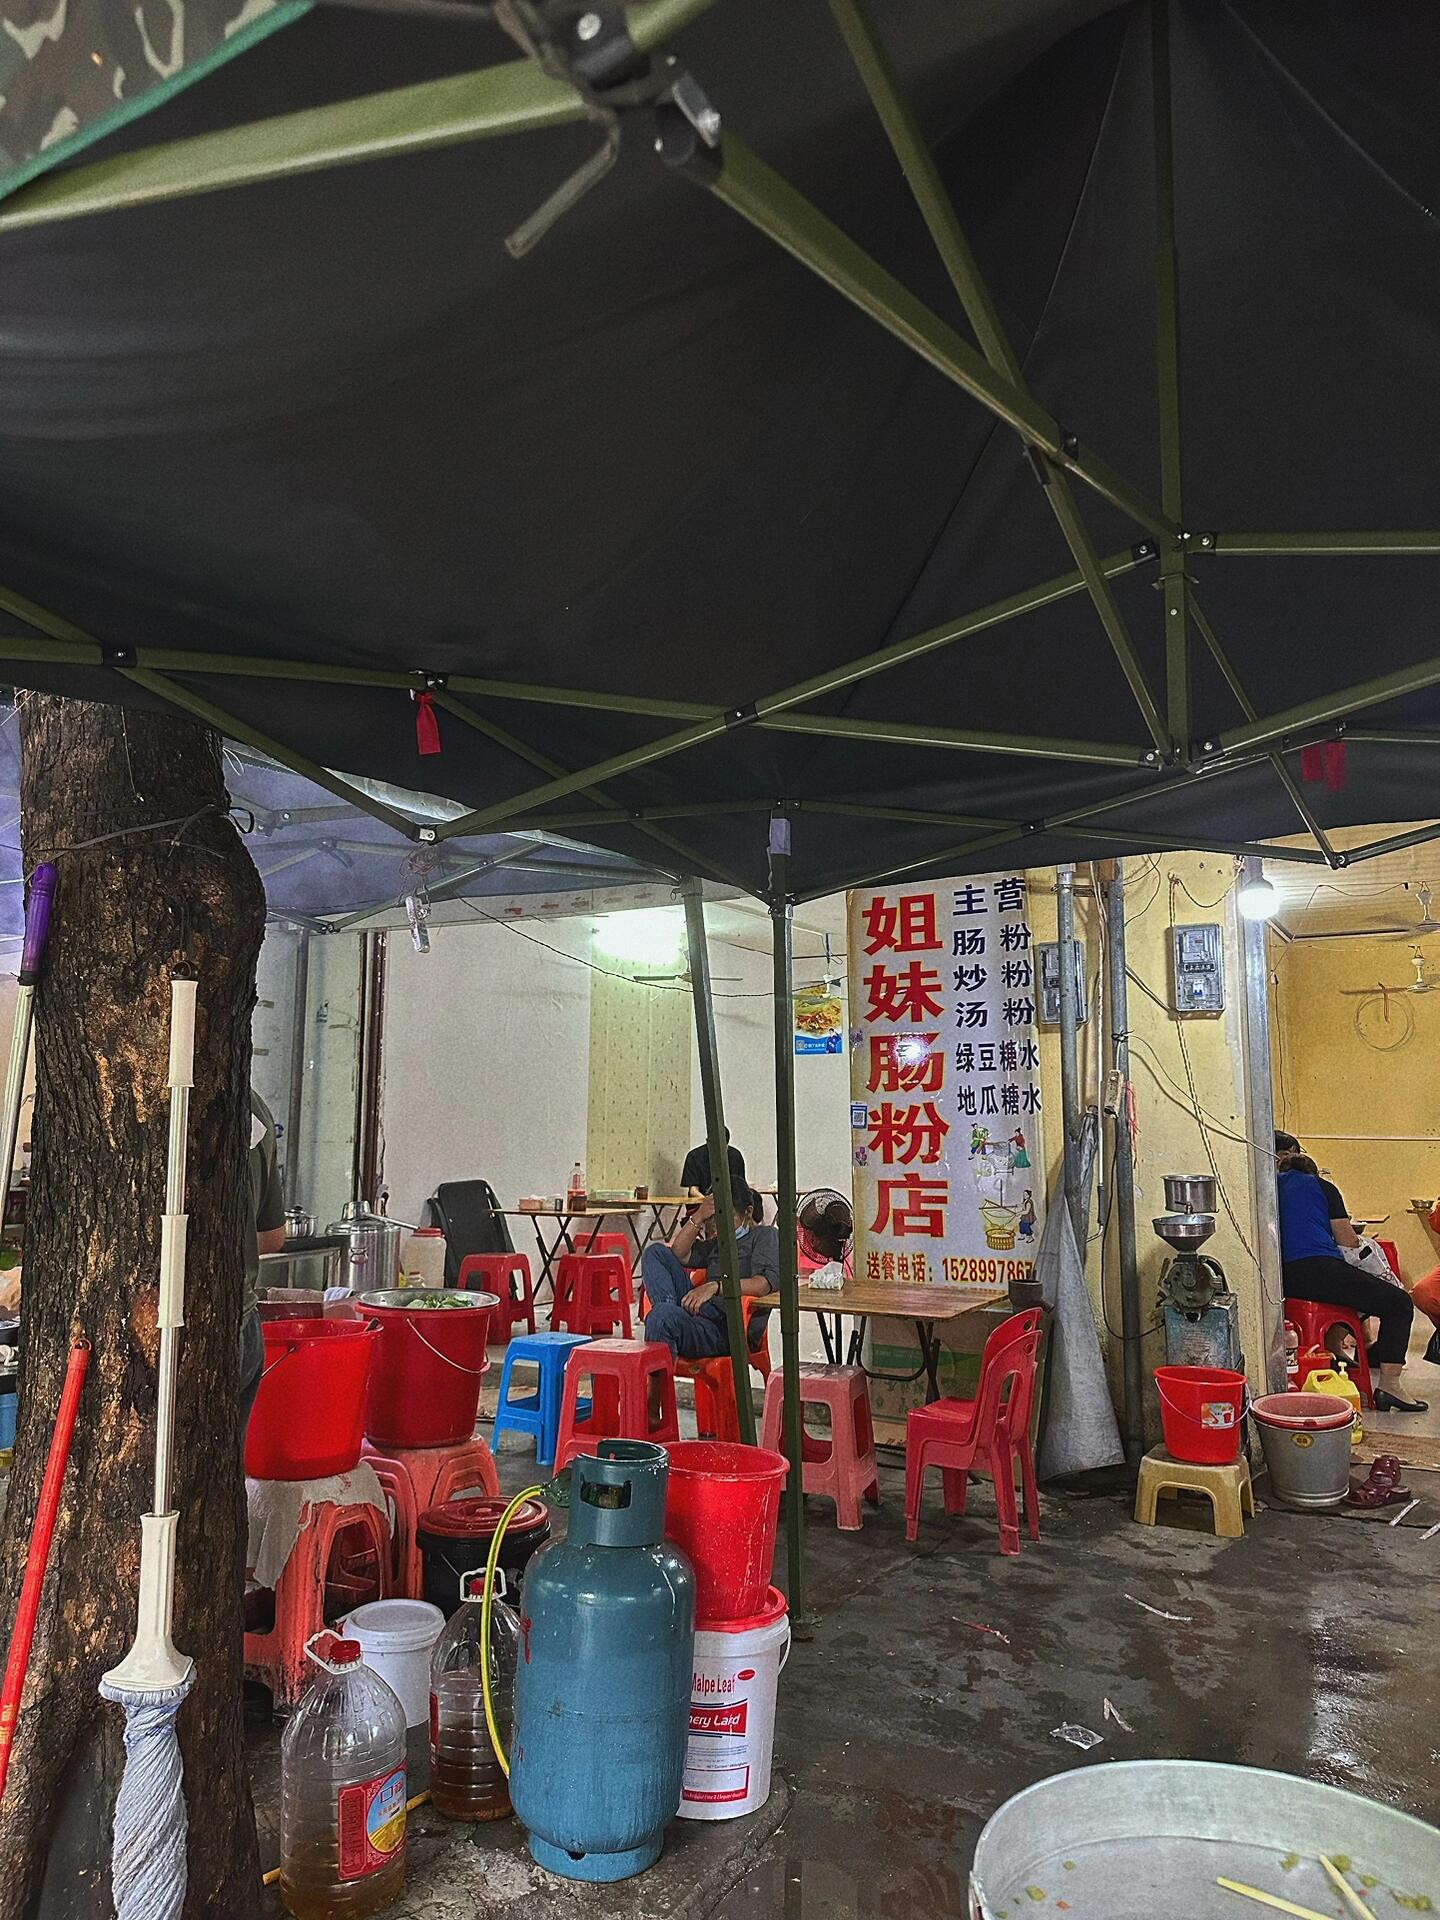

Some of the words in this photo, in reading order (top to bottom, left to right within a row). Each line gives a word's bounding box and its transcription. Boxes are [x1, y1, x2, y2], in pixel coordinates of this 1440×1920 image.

[952, 877, 1027, 916] 主营
[952, 923, 1032, 956] 肠粉
[953, 960, 1033, 992] 炒粉
[955, 997, 1035, 1028] 汤粉
[862, 894, 950, 1238] 姐妹肠粉店
[955, 1039, 1040, 1073] 绿豆糖水
[957, 1083, 1042, 1115] 地瓜糖水
[717, 1673, 736, 1693] Leaf
